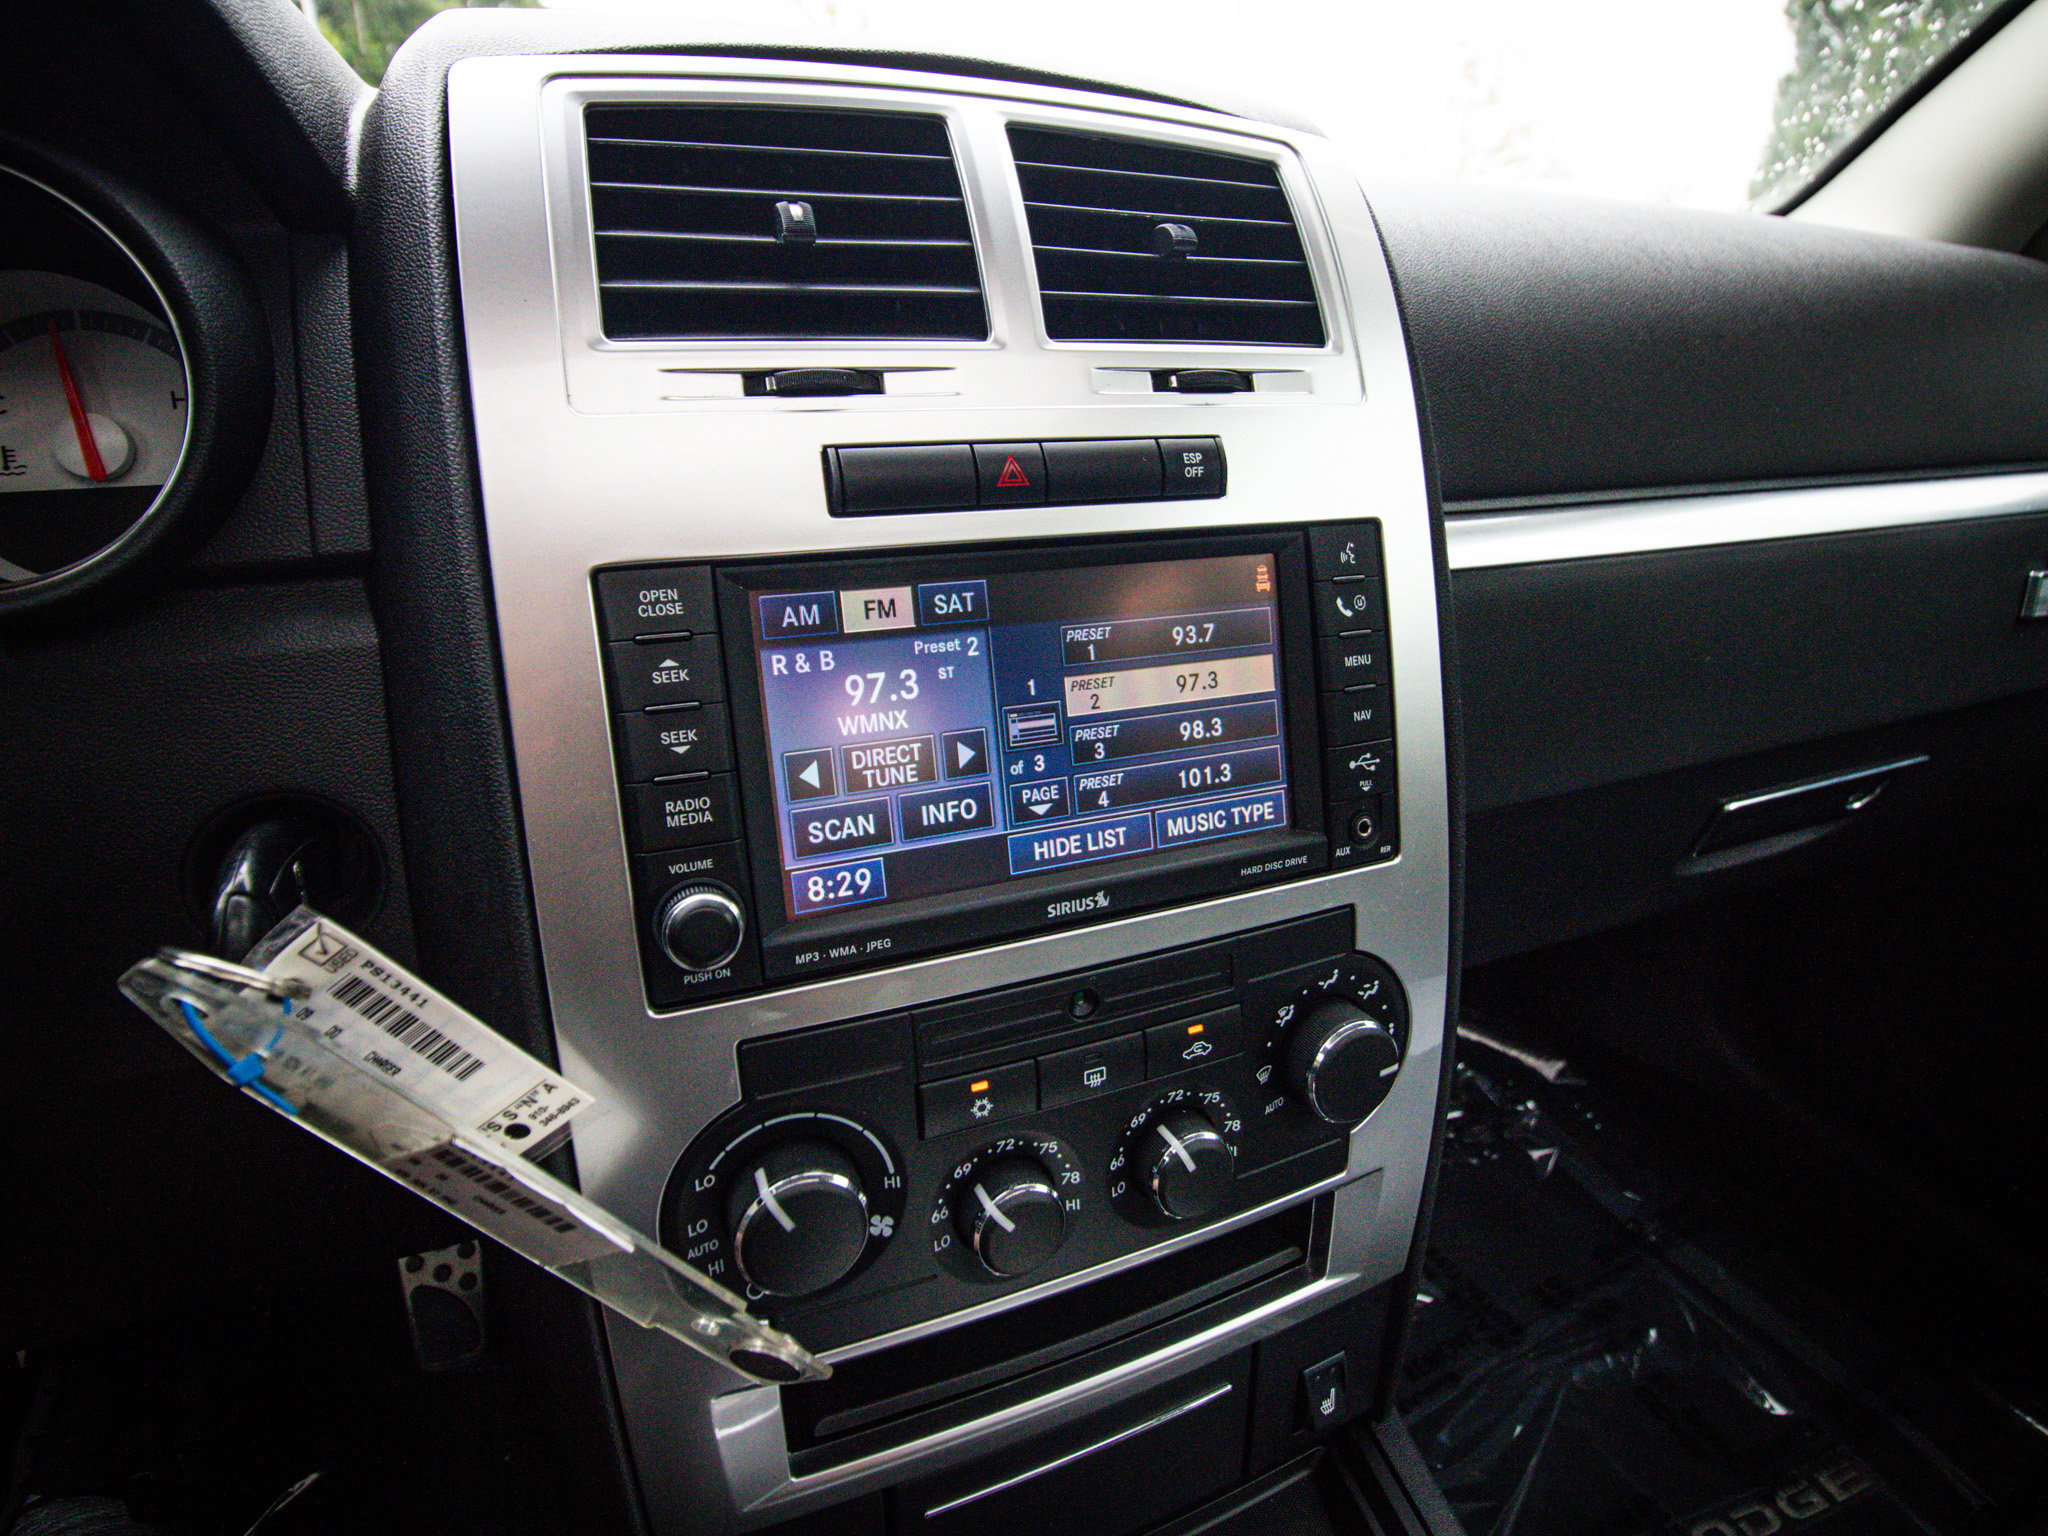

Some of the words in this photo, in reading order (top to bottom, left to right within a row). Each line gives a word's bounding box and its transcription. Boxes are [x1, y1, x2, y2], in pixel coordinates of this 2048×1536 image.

[1182, 452, 1202, 464] ESP
[1184, 466, 1204, 478] OFF
[639, 588, 678, 602] OPEN
[934, 592, 974, 614] SAT
[638, 602, 684, 618] CLOSE
[782, 604, 820, 628] AM
[864, 598, 896, 620] FM
[1066, 626, 1112, 642] PRESET
[1172, 623, 1215, 646] 93.7
[914, 638, 961, 655] Preset
[966, 636, 980, 656] 2
[1087, 644, 1095, 661] 1
[772, 654, 788, 676] R
[795, 653, 811, 673] &
[820, 650, 836, 671] B
[1344, 654, 1372, 667] MENU
[652, 668, 690, 684] SEEK
[938, 666, 954, 680] ST
[844, 668, 920, 706] 97.3
[1027, 678, 1036, 696] 1
[1070, 676, 1116, 692] PRESET
[1176, 671, 1218, 694] 97.3
[1090, 694, 1100, 710] 2
[836, 709, 909, 736] WMNX
[1354, 709, 1372, 722] NAV
[660, 728, 698, 745] SEEK
[1074, 724, 1120, 742] PRESET
[1180, 718, 1222, 741] 98.3
[851, 743, 922, 770] DIRECT
[1094, 743, 1105, 760] 3
[1010, 760, 1024, 776] of
[1034, 754, 1046, 772] 3
[862, 764, 919, 788] TUNE
[1078, 773, 1124, 790] PRESET
[1178, 764, 1232, 789] 101.3
[1022, 785, 1060, 804] PAGE
[1098, 791, 1110, 808] 4
[665, 796, 710, 814] RADIO
[922, 798, 978, 826] INFO
[666, 810, 713, 828] MEDIA
[1166, 811, 1226, 838] MUSIC
[1230, 802, 1275, 826] TYPE
[808, 814, 876, 844] SCAN
[1034, 836, 1082, 861] HIDE
[1087, 827, 1127, 852] LIST
[1335, 846, 1350, 857] AUX
[668, 858, 714, 875] VOLUME
[1240, 864, 1263, 877] HARD
[1264, 861, 1283, 872] DISC
[1284, 856, 1308, 868] DRIVE
[806, 868, 872, 902] 8:29
[1047, 896, 1095, 918] SIRIUS
[795, 951, 820, 966] MP3
[829, 945, 857, 959] WMA
[866, 938, 892, 952] JPEG
[684, 970, 712, 986] PUSH
[714, 968, 731, 978] ON
[1168, 1090, 1184, 1104] 72
[1204, 1092, 1220, 1104] 75
[1264, 1097, 1284, 1115] AUTO
[1130, 1114, 1146, 1128] 69
[1224, 1120, 1240, 1133] 78
[996, 1138, 1015, 1153] 72
[1040, 1142, 1058, 1155] 75
[954, 1162, 972, 1179] 69
[1110, 1154, 1125, 1170] 66
[694, 1174, 716, 1192] LO
[884, 1176, 901, 1189] HI
[1062, 1172, 1080, 1185] 78
[1112, 1182, 1126, 1198] LO
[1066, 1199, 1080, 1211] HI
[932, 1206, 948, 1224] 66
[687, 1219, 708, 1238] LO
[687, 1239, 719, 1260] AUTO
[934, 1234, 950, 1252] LO
[708, 1258, 724, 1276] HI
